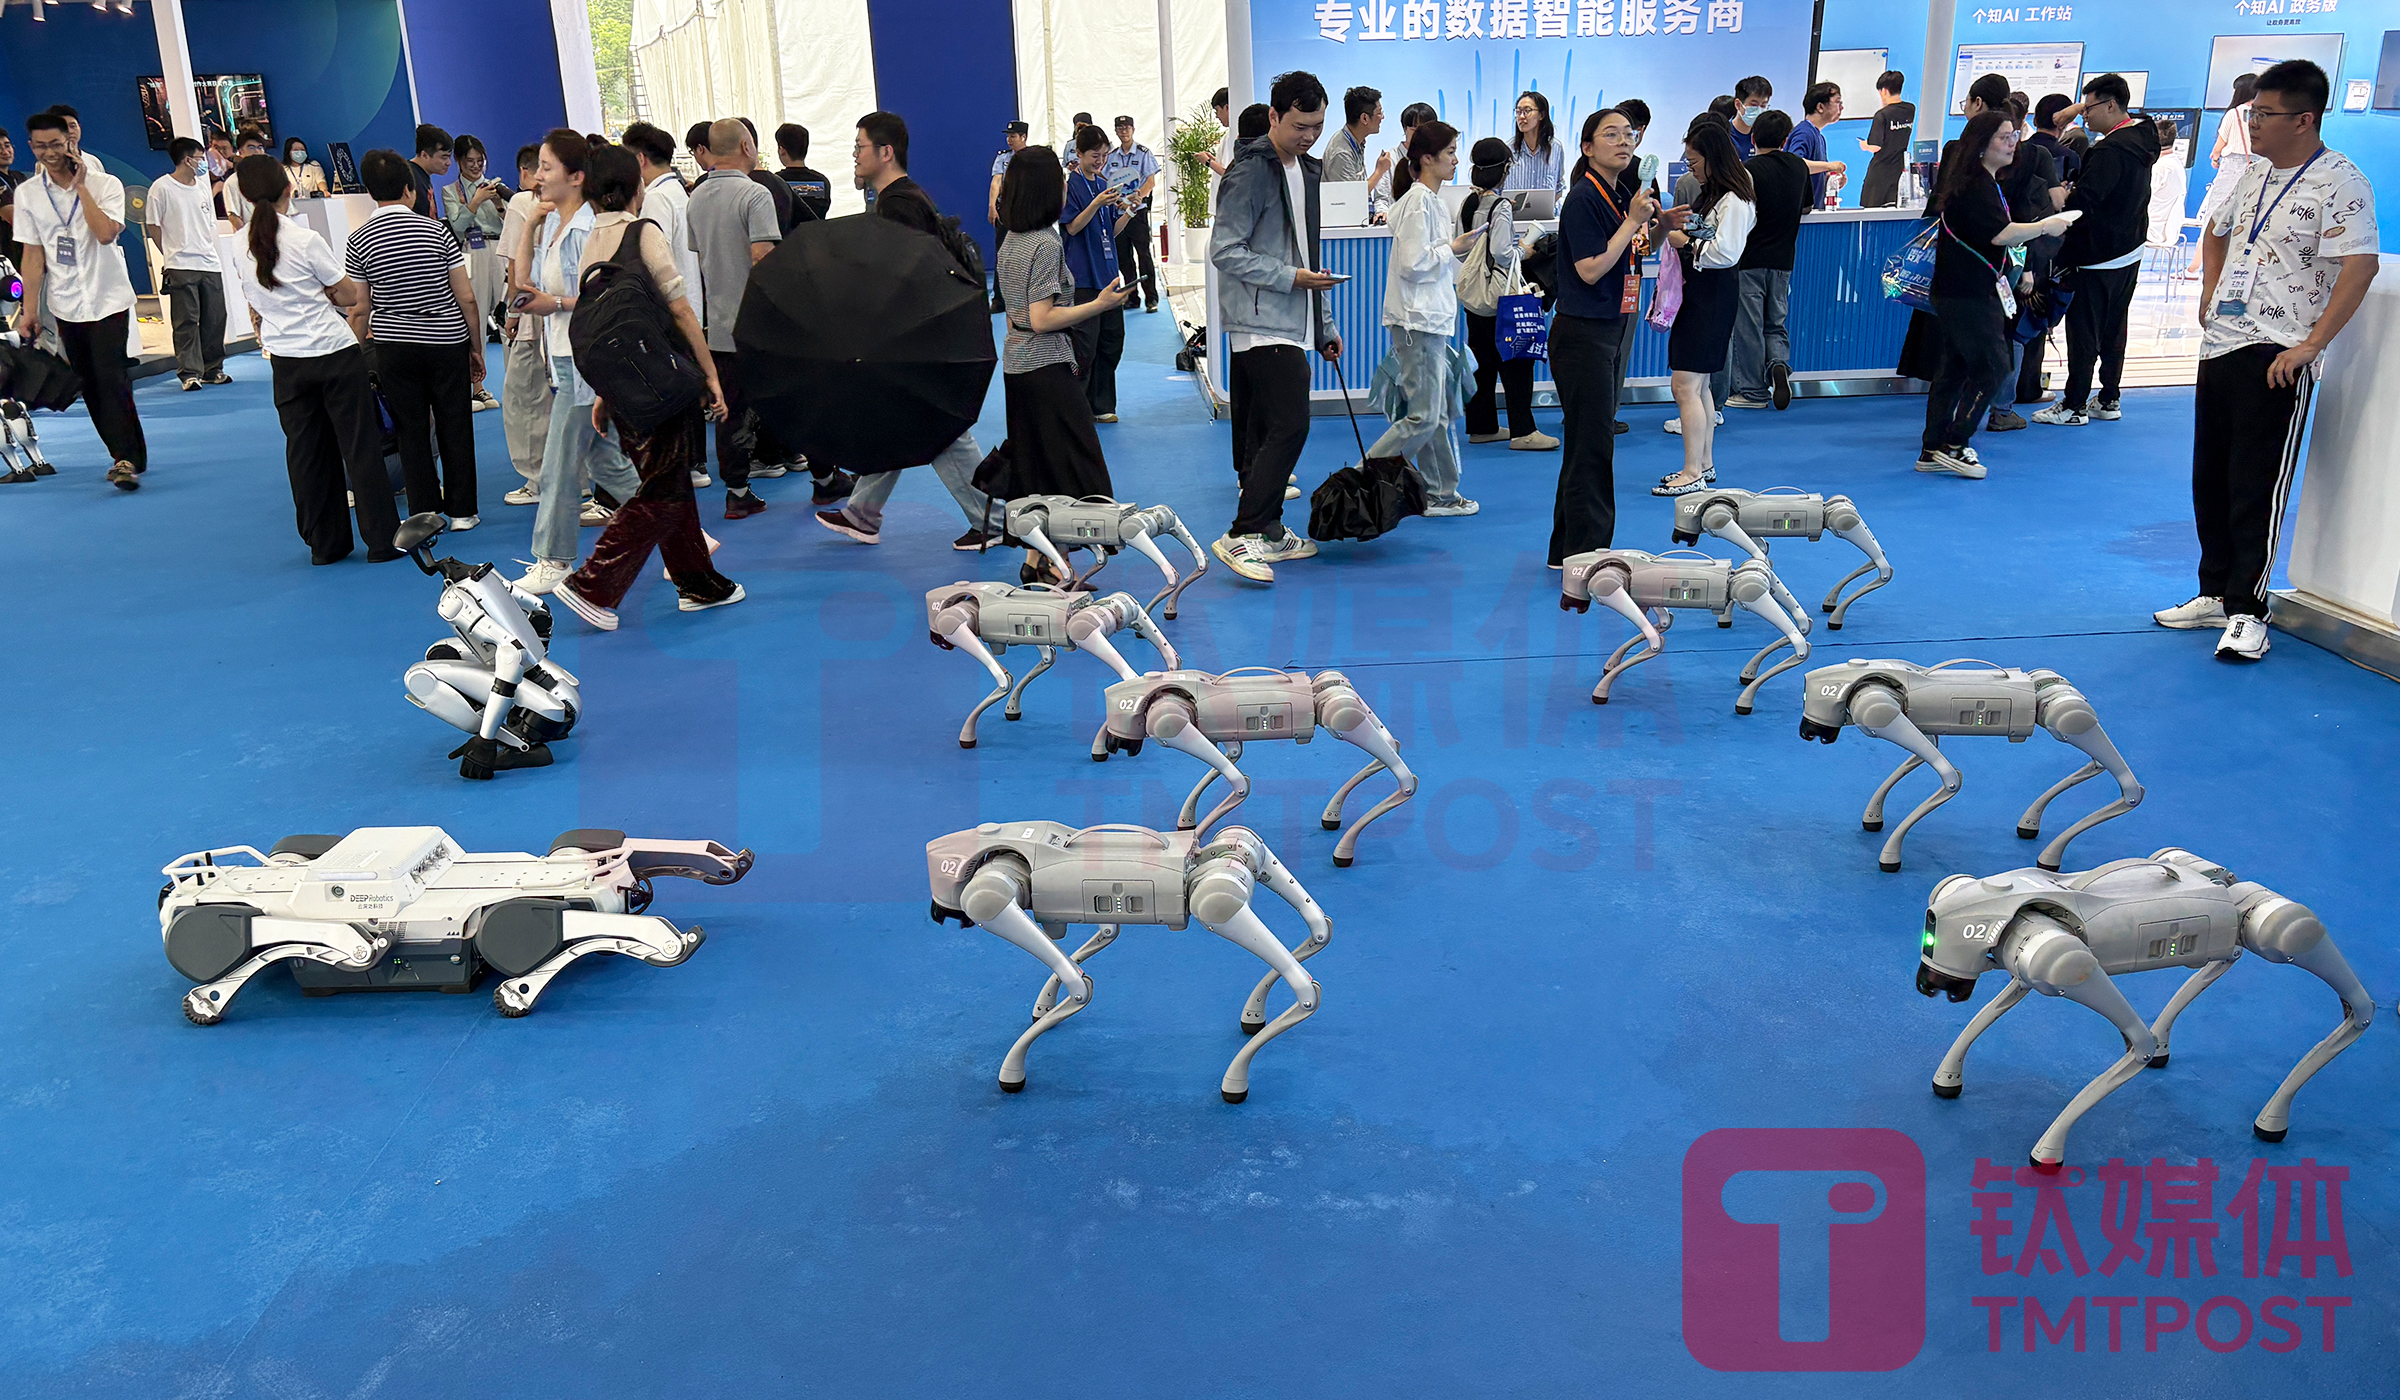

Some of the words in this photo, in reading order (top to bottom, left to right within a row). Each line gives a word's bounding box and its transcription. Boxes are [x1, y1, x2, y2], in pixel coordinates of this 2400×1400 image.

[1972, 7, 2020, 24] 个知AI
[2024, 5, 2073, 22] 工作站
[2234, 0, 2285, 16] 个知AI
[2289, 0, 2338, 14] 政务版
[1314, 0, 1744, 44] 专业的数据智能服务商
[2289, 202, 2316, 222] Wake
[2258, 303, 2286, 320] Wake
[1684, 504, 1696, 513] 02
[1572, 565, 1582, 575] 02
[1820, 684, 1836, 696] 02
[1119, 699, 1133, 710] 02
[940, 859, 956, 874] 02
[1962, 923, 1987, 939] 02
